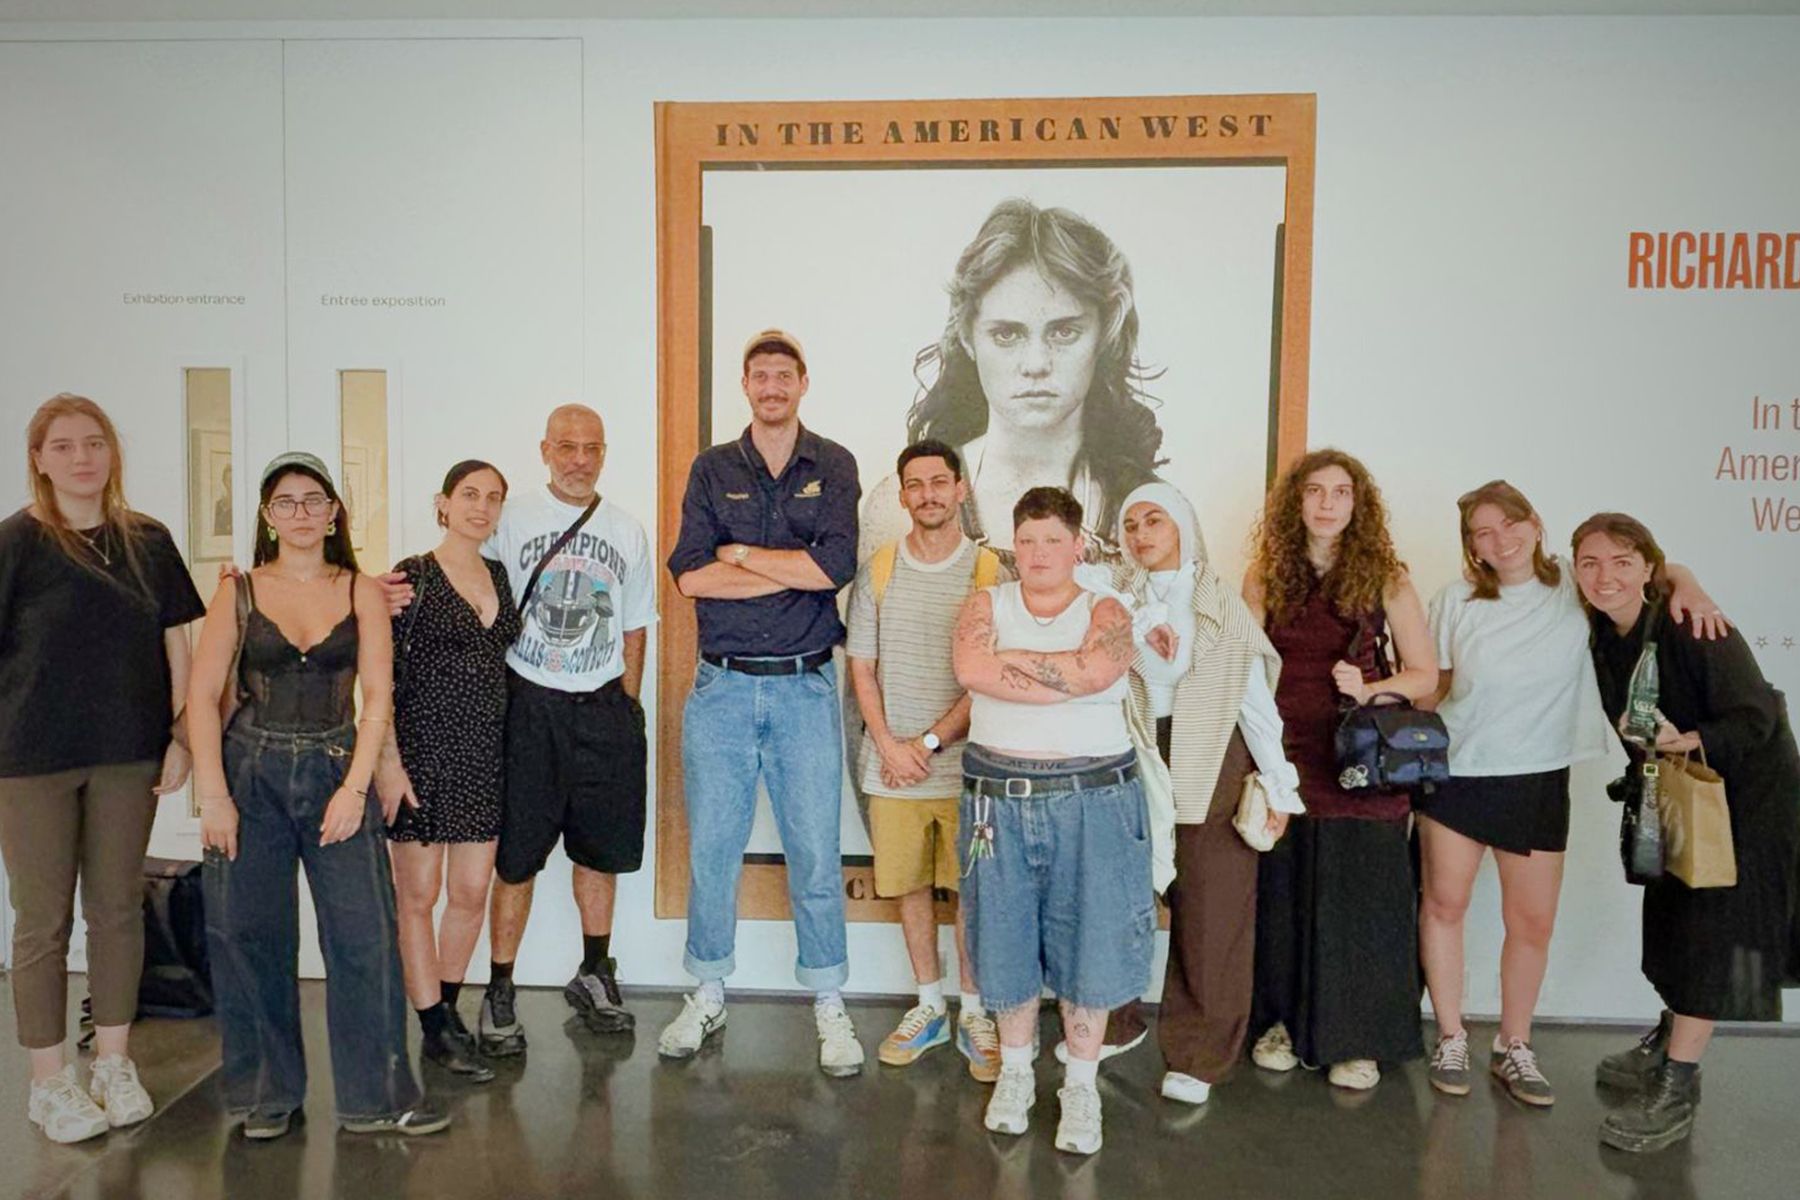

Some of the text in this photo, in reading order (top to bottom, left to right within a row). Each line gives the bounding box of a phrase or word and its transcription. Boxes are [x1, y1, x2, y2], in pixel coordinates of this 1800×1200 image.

[716, 113, 1274, 147] IN THE AMERICAN WEST
[1628, 231, 1800, 290] RICHARD
[123, 293, 246, 305] Exhibition entrance
[372, 295, 446, 308] exposition
[1753, 396, 1780, 430] In
